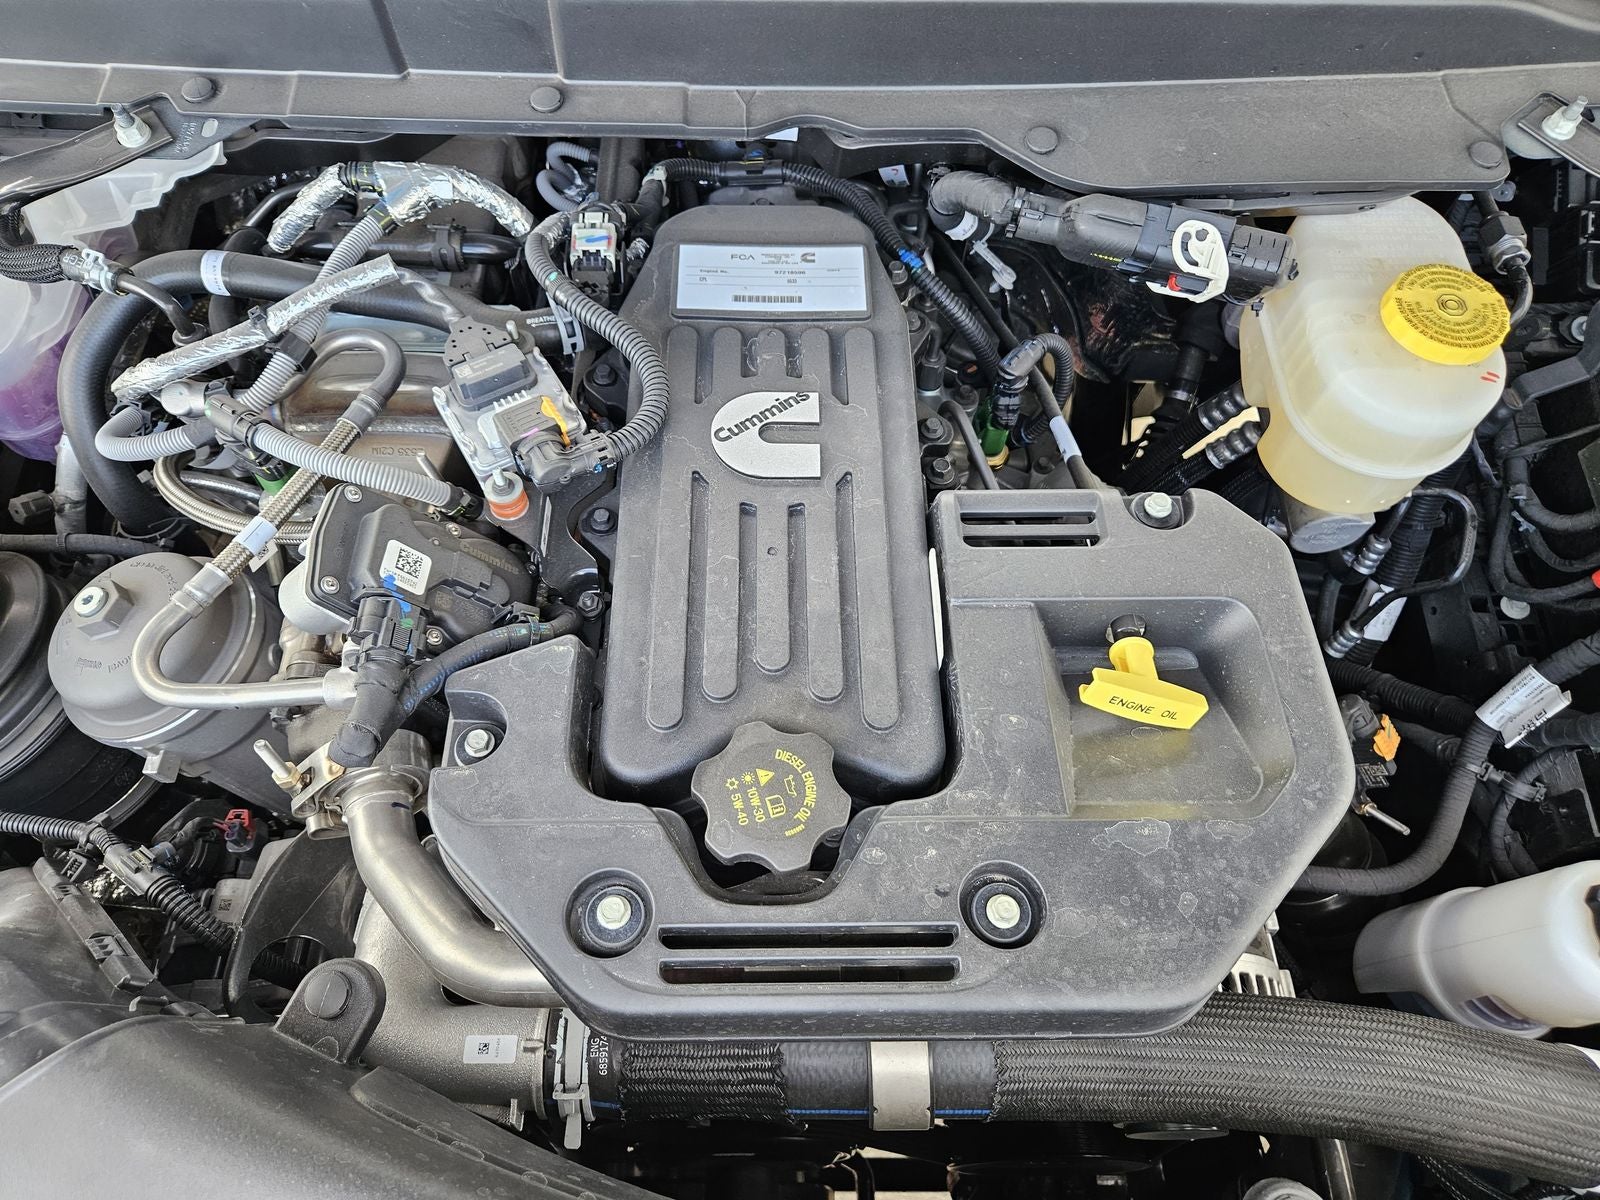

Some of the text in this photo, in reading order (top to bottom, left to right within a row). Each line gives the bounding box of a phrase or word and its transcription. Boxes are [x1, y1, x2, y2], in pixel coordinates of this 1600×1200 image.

[63, 253, 84, 268] EGR
[713, 392, 811, 442] Cummins
[460, 540, 519, 575] Cummins
[1108, 696, 1178, 720] ENGINE OIL
[775, 749, 807, 774] DIESEL
[802, 770, 817, 809] ENGINE
[730, 793, 749, 826] 5W-40
[747, 786, 766, 823] 10W-30
[793, 806, 811, 822] OIL
[590, 1036, 600, 1058] ENG
